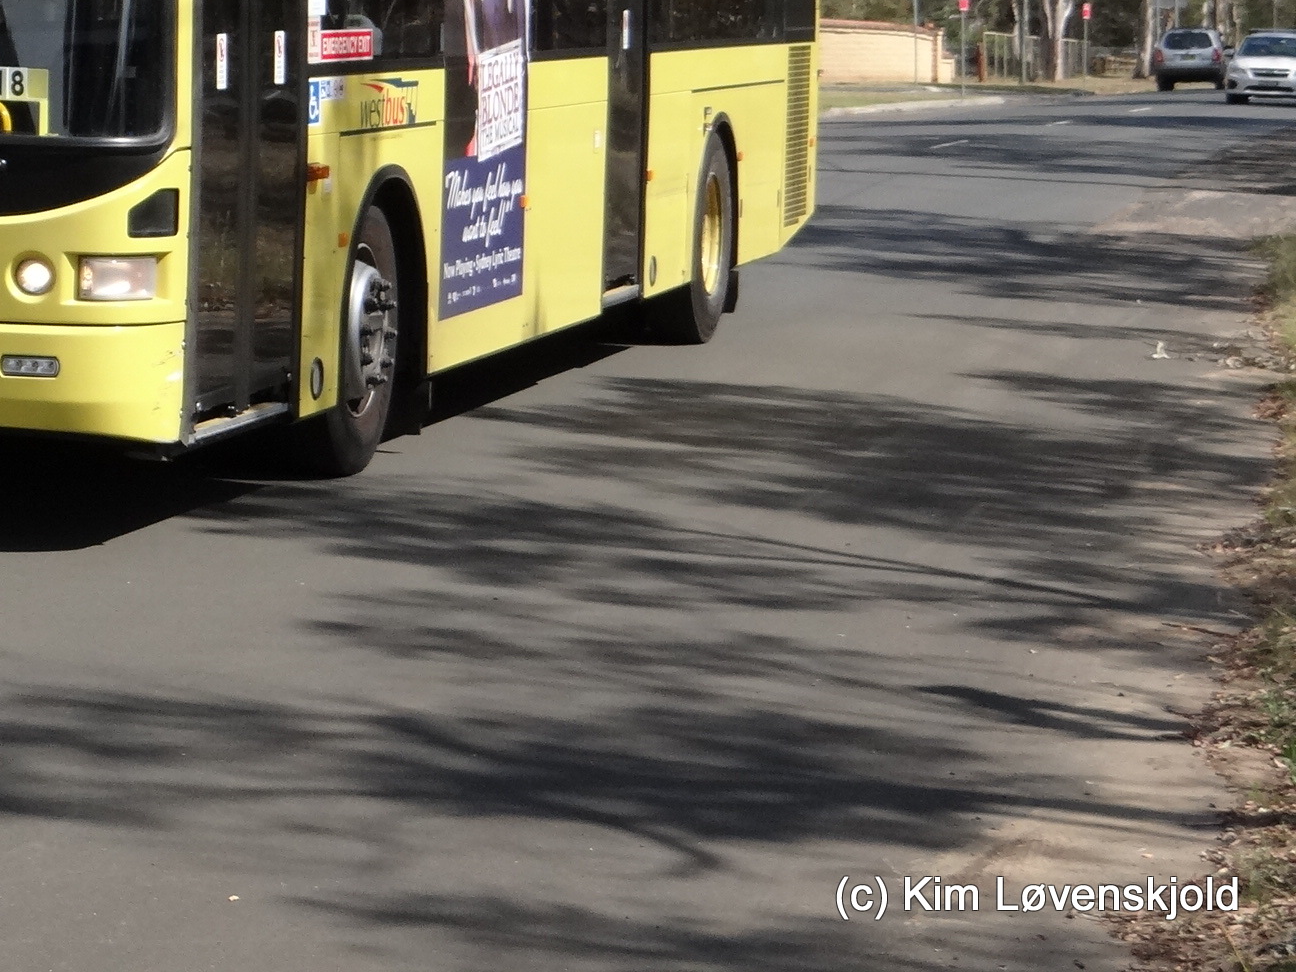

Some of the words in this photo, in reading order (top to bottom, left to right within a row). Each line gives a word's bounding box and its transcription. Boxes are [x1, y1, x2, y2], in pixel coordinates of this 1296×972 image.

[322, 36, 358, 55] EMERGENCY
[358, 35, 371, 53] EXIT
[481, 51, 519, 92] LEGALLY
[360, 88, 405, 128] westbus
[481, 82, 519, 127] BLONDE
[494, 115, 519, 140] MUSICAL
[470, 187, 484, 220] you
[483, 164, 501, 213] feel
[510, 179, 523, 211] you
[462, 216, 480, 242] want
[479, 215, 487, 238] to
[444, 262, 455, 279] Now
[455, 259, 473, 277] Playing
[475, 253, 492, 274] Sydney
[492, 248, 503, 269] Lyric
[503, 246, 521, 263] Theatre
